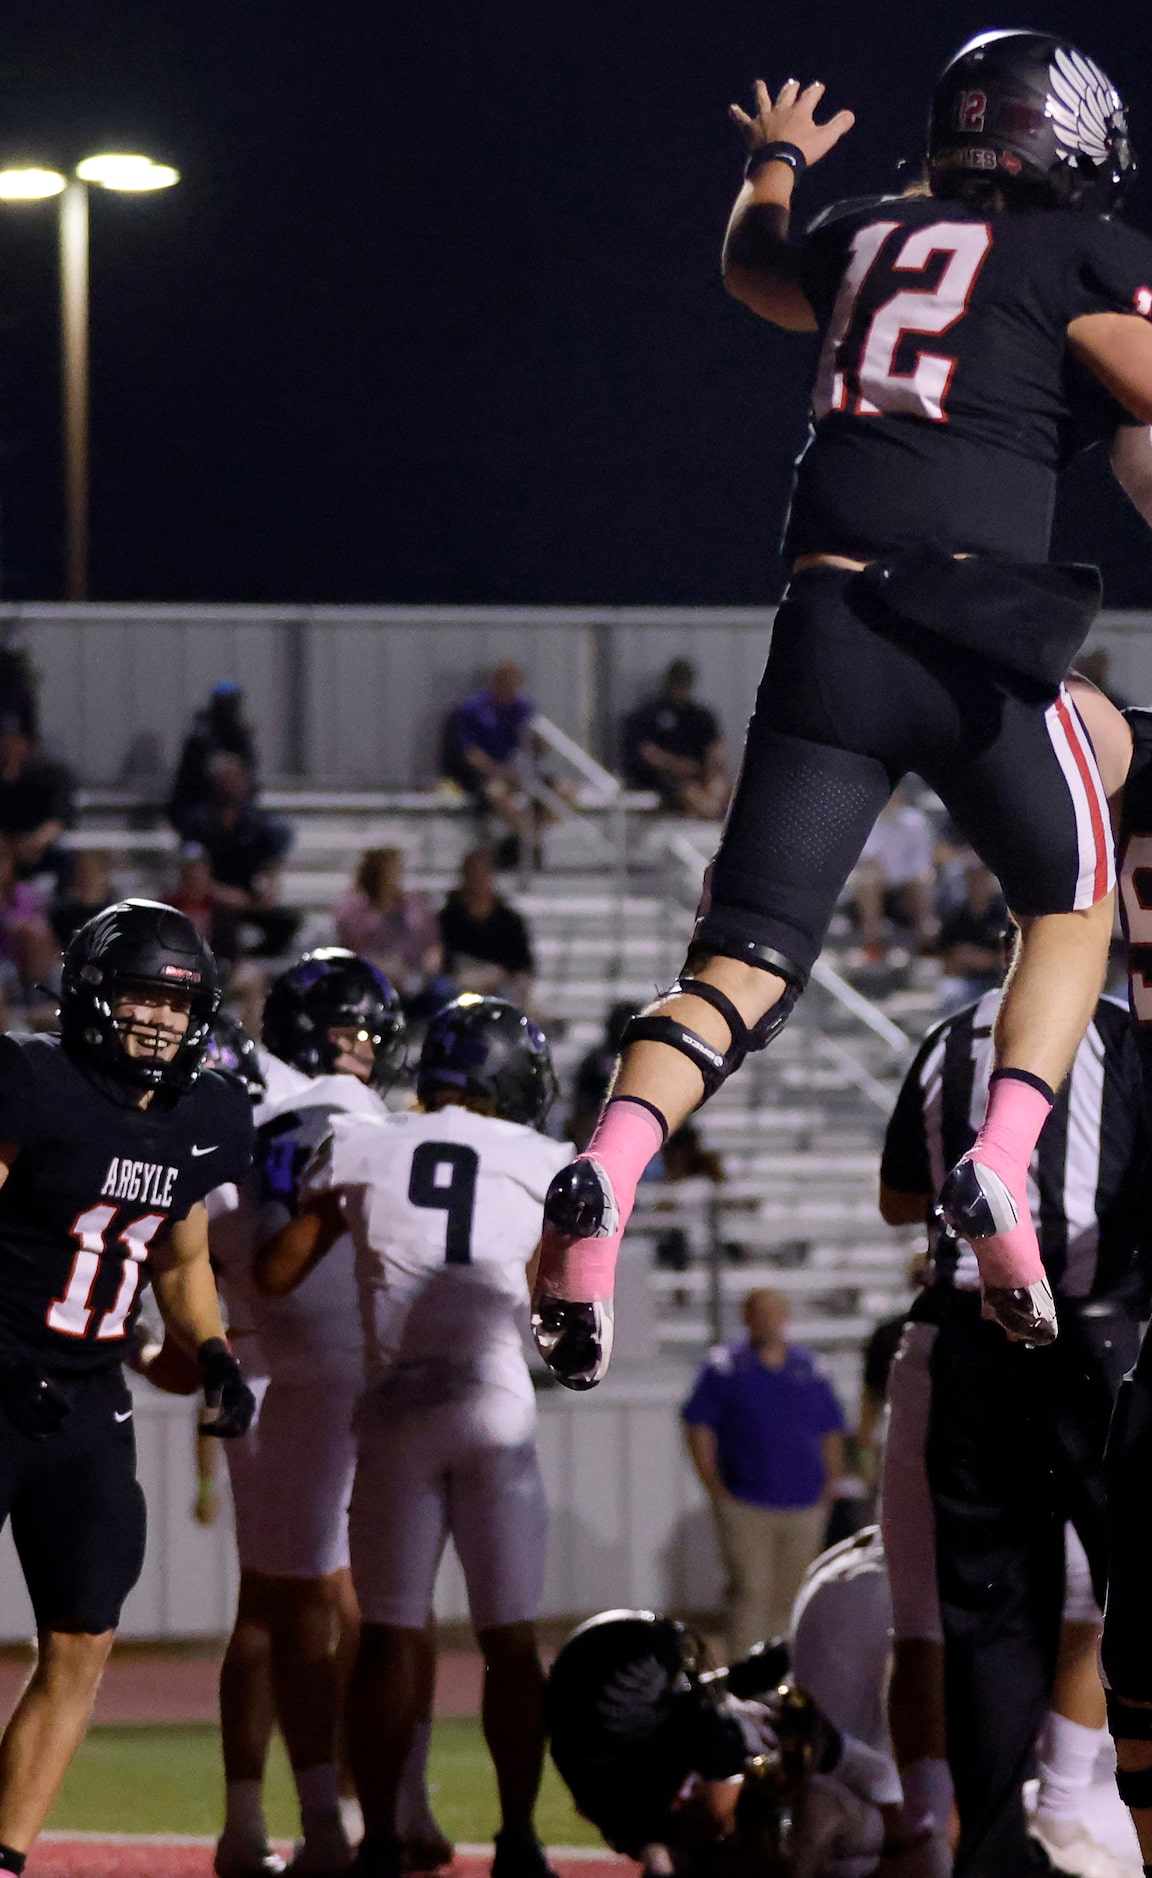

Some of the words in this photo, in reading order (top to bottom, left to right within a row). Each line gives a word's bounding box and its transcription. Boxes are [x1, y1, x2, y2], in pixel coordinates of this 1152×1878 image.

[812, 221, 993, 423] 12
[101, 1156, 179, 1208] ARGYLE
[407, 1139, 480, 1265] 9
[45, 1201, 168, 1340] 11
